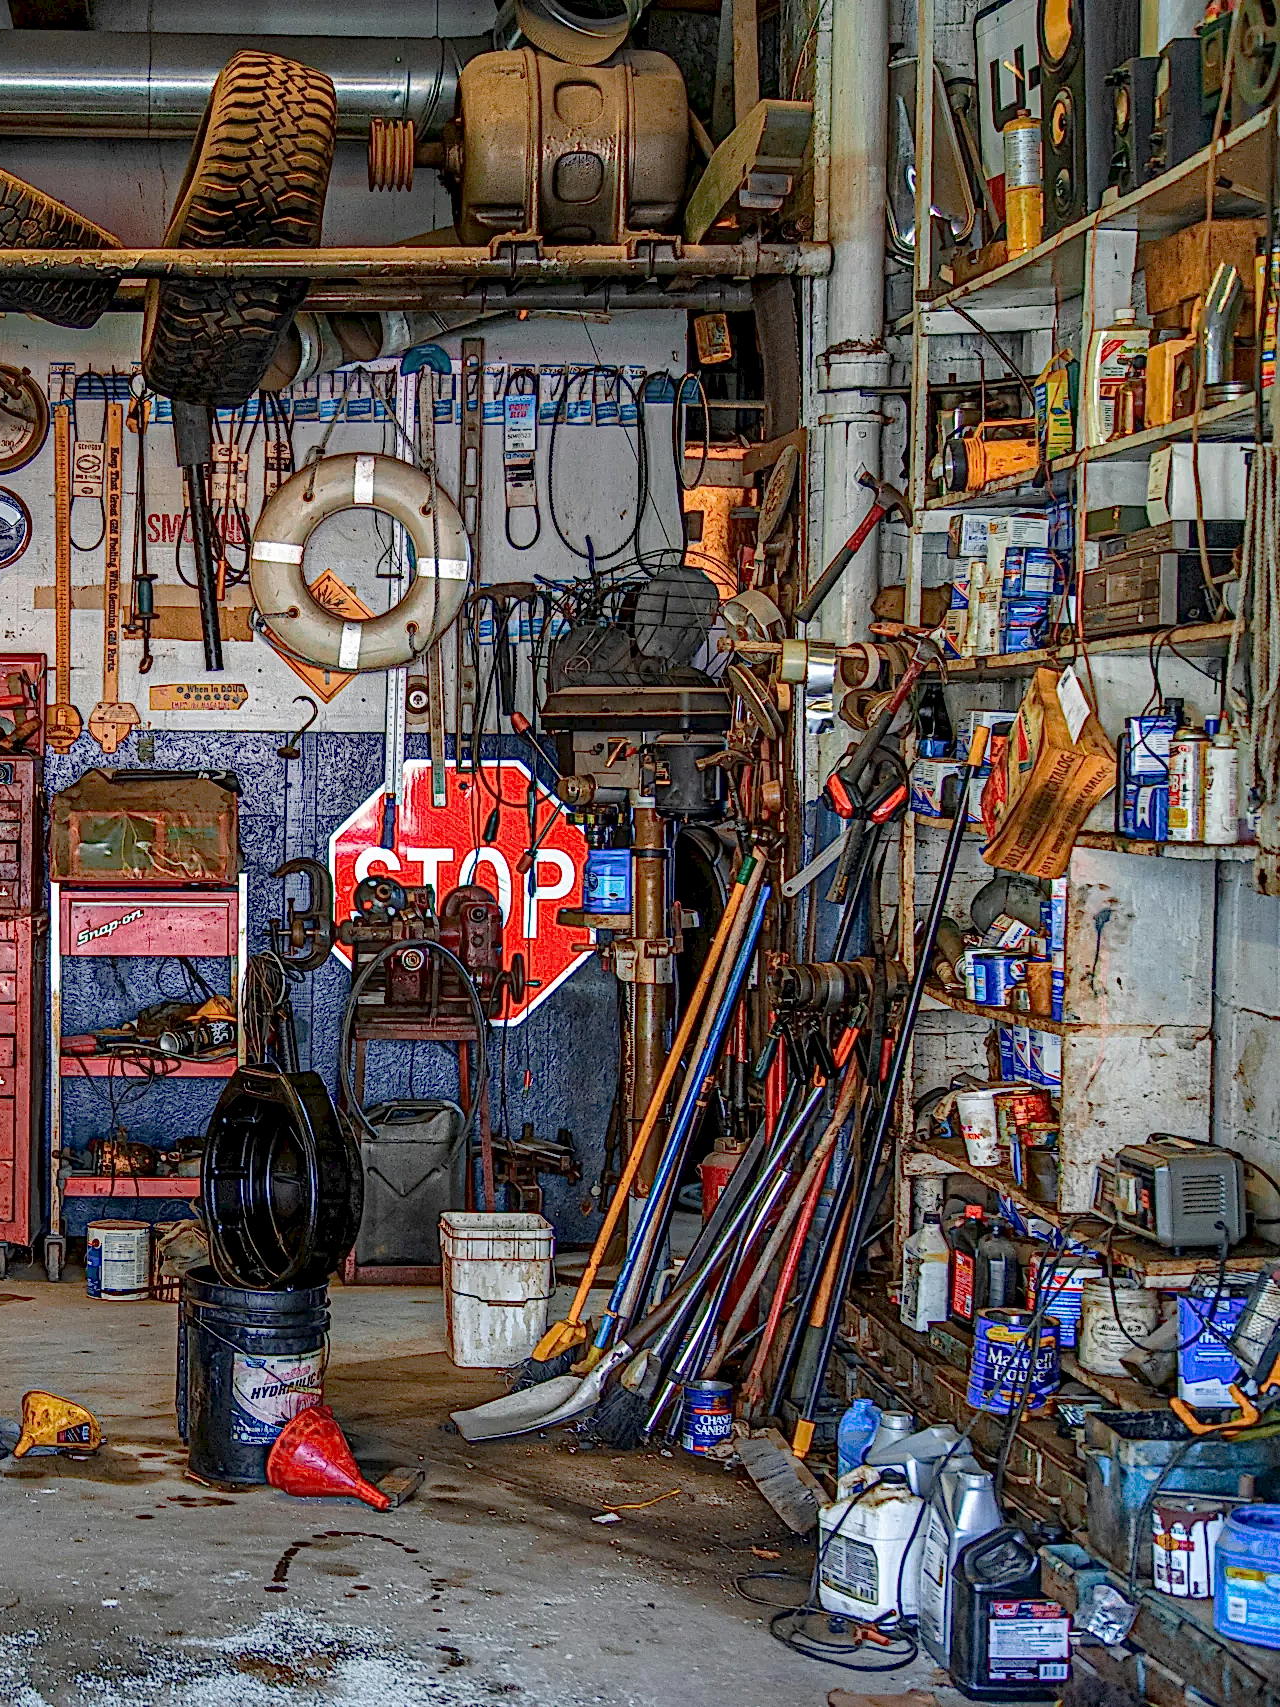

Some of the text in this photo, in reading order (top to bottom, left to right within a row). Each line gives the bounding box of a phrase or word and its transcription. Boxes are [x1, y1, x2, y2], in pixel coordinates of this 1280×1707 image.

[108, 447, 120, 469] Keep
[109, 470, 119, 491] That
[109, 494, 119, 517] Great
[109, 519, 119, 534] GM
[107, 537, 119, 568] Feeling
[108, 570, 118, 592] With
[107, 593, 118, 628] Genuine
[107, 630, 117, 645] GM
[1045, 752, 1076, 793] CATALOG
[1081, 765, 1111, 803] CATALOG
[349, 847, 575, 939] STOP
[77, 909, 144, 946] Snap-on
[994, 1364, 1046, 1383] House
